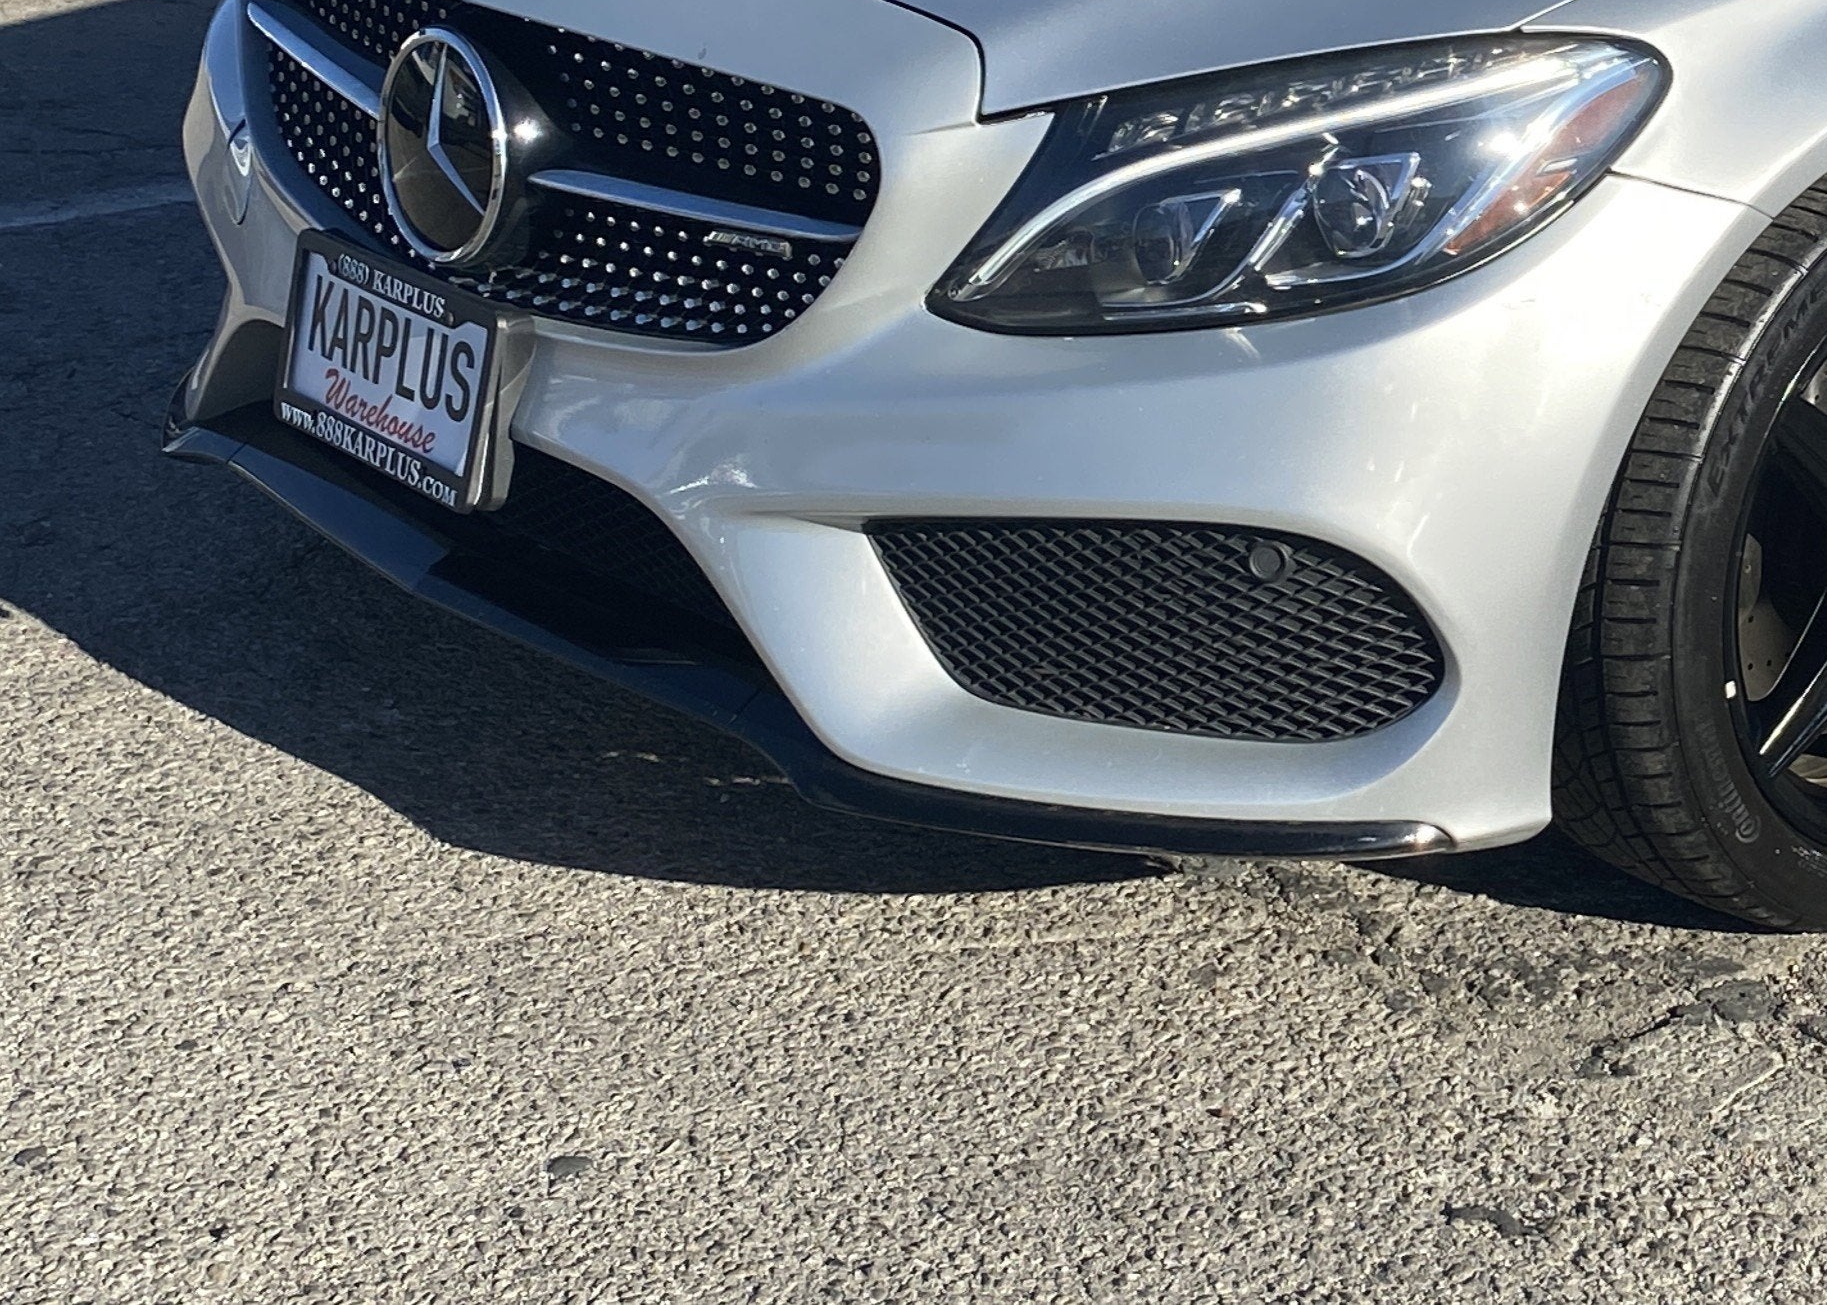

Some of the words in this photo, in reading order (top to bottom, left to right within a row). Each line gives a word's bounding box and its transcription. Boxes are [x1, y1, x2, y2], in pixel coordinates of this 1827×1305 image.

[337, 253, 370, 285] (888)
[373, 270, 446, 318] KARPLUS
[308, 274, 476, 423] KARPLUS
[324, 367, 437, 455] Warehouse
